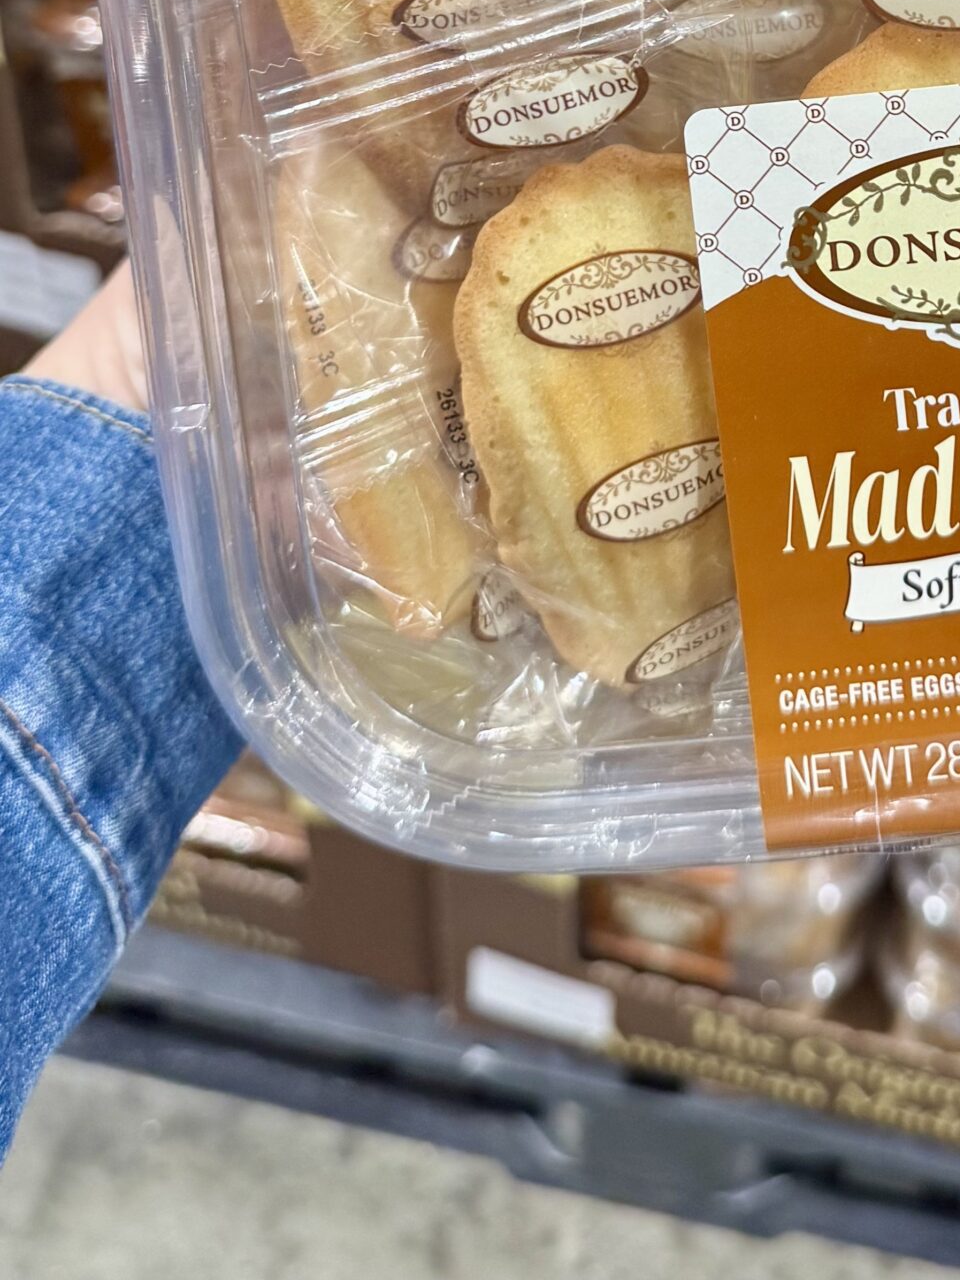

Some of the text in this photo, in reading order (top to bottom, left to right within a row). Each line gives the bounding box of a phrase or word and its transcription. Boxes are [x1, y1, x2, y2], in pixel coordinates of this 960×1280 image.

[472, 74, 638, 135] DONSUEMOR
[534, 276, 698, 332] DONSUEMOR
[317, 350, 340, 378] 3C
[436, 388, 480, 484] 26133 3C
[595, 463, 725, 528] DONSUEM
[778, 677, 905, 713] CAGE-FREE
[784, 751, 853, 797] NET
[860, 745, 920, 788] WT
